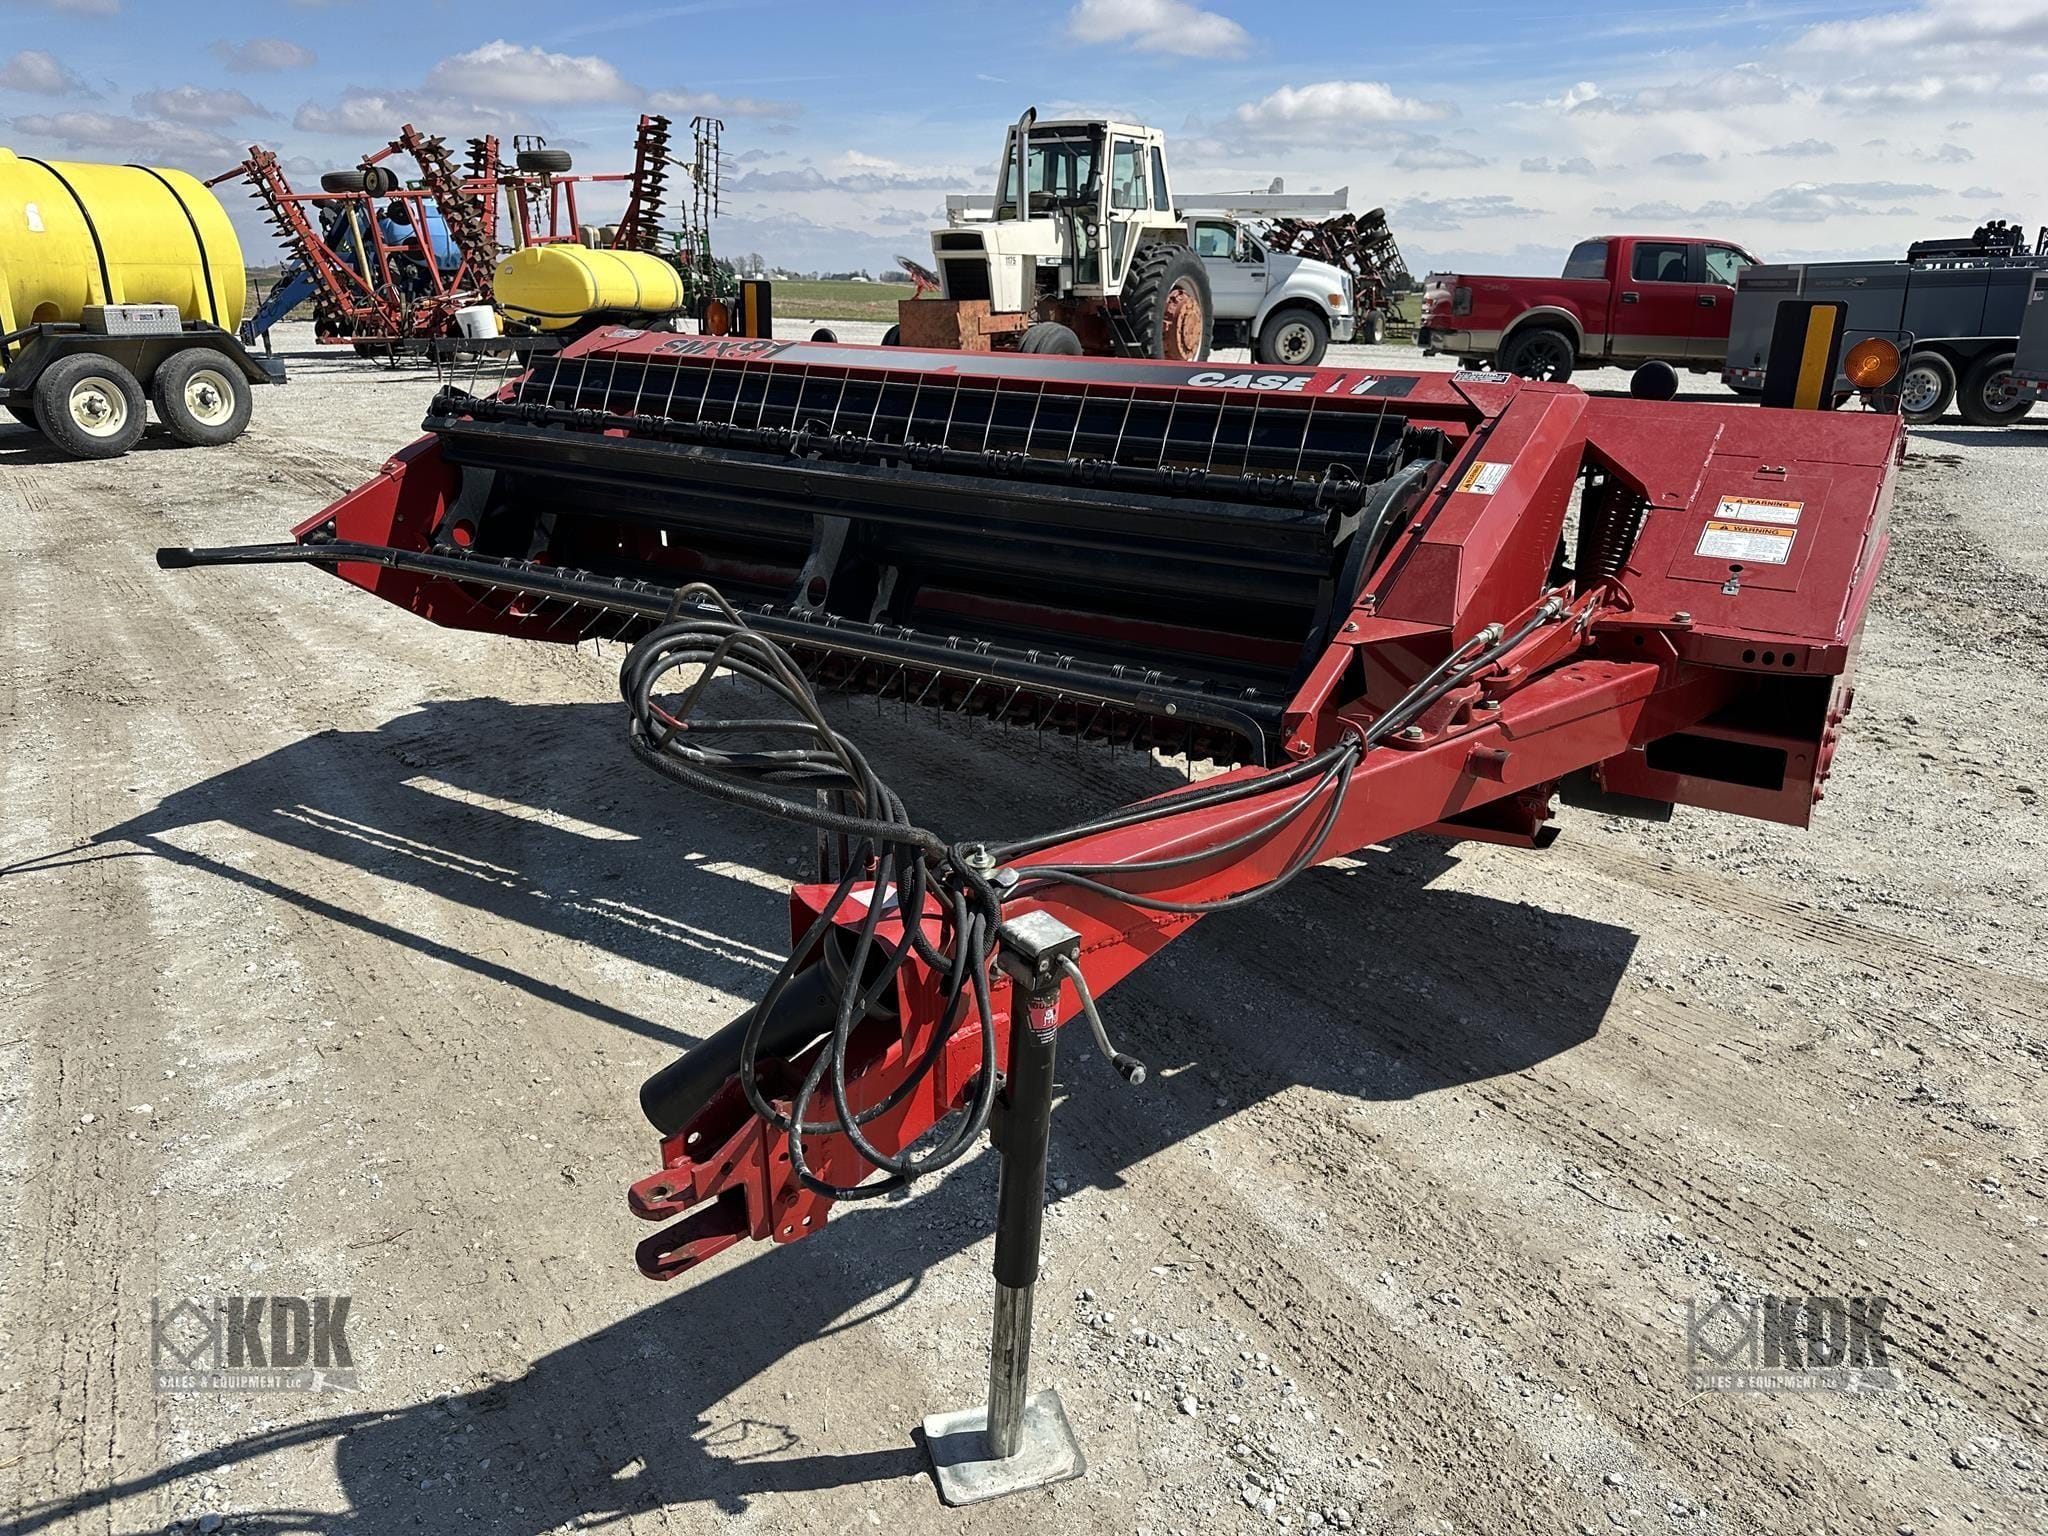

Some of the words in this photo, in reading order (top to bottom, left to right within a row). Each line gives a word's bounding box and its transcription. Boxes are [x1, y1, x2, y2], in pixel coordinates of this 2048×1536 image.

[1187, 371, 1311, 392] CASE
[1747, 499, 1789, 508] WARNING
[1733, 526, 1779, 535] WARNING
